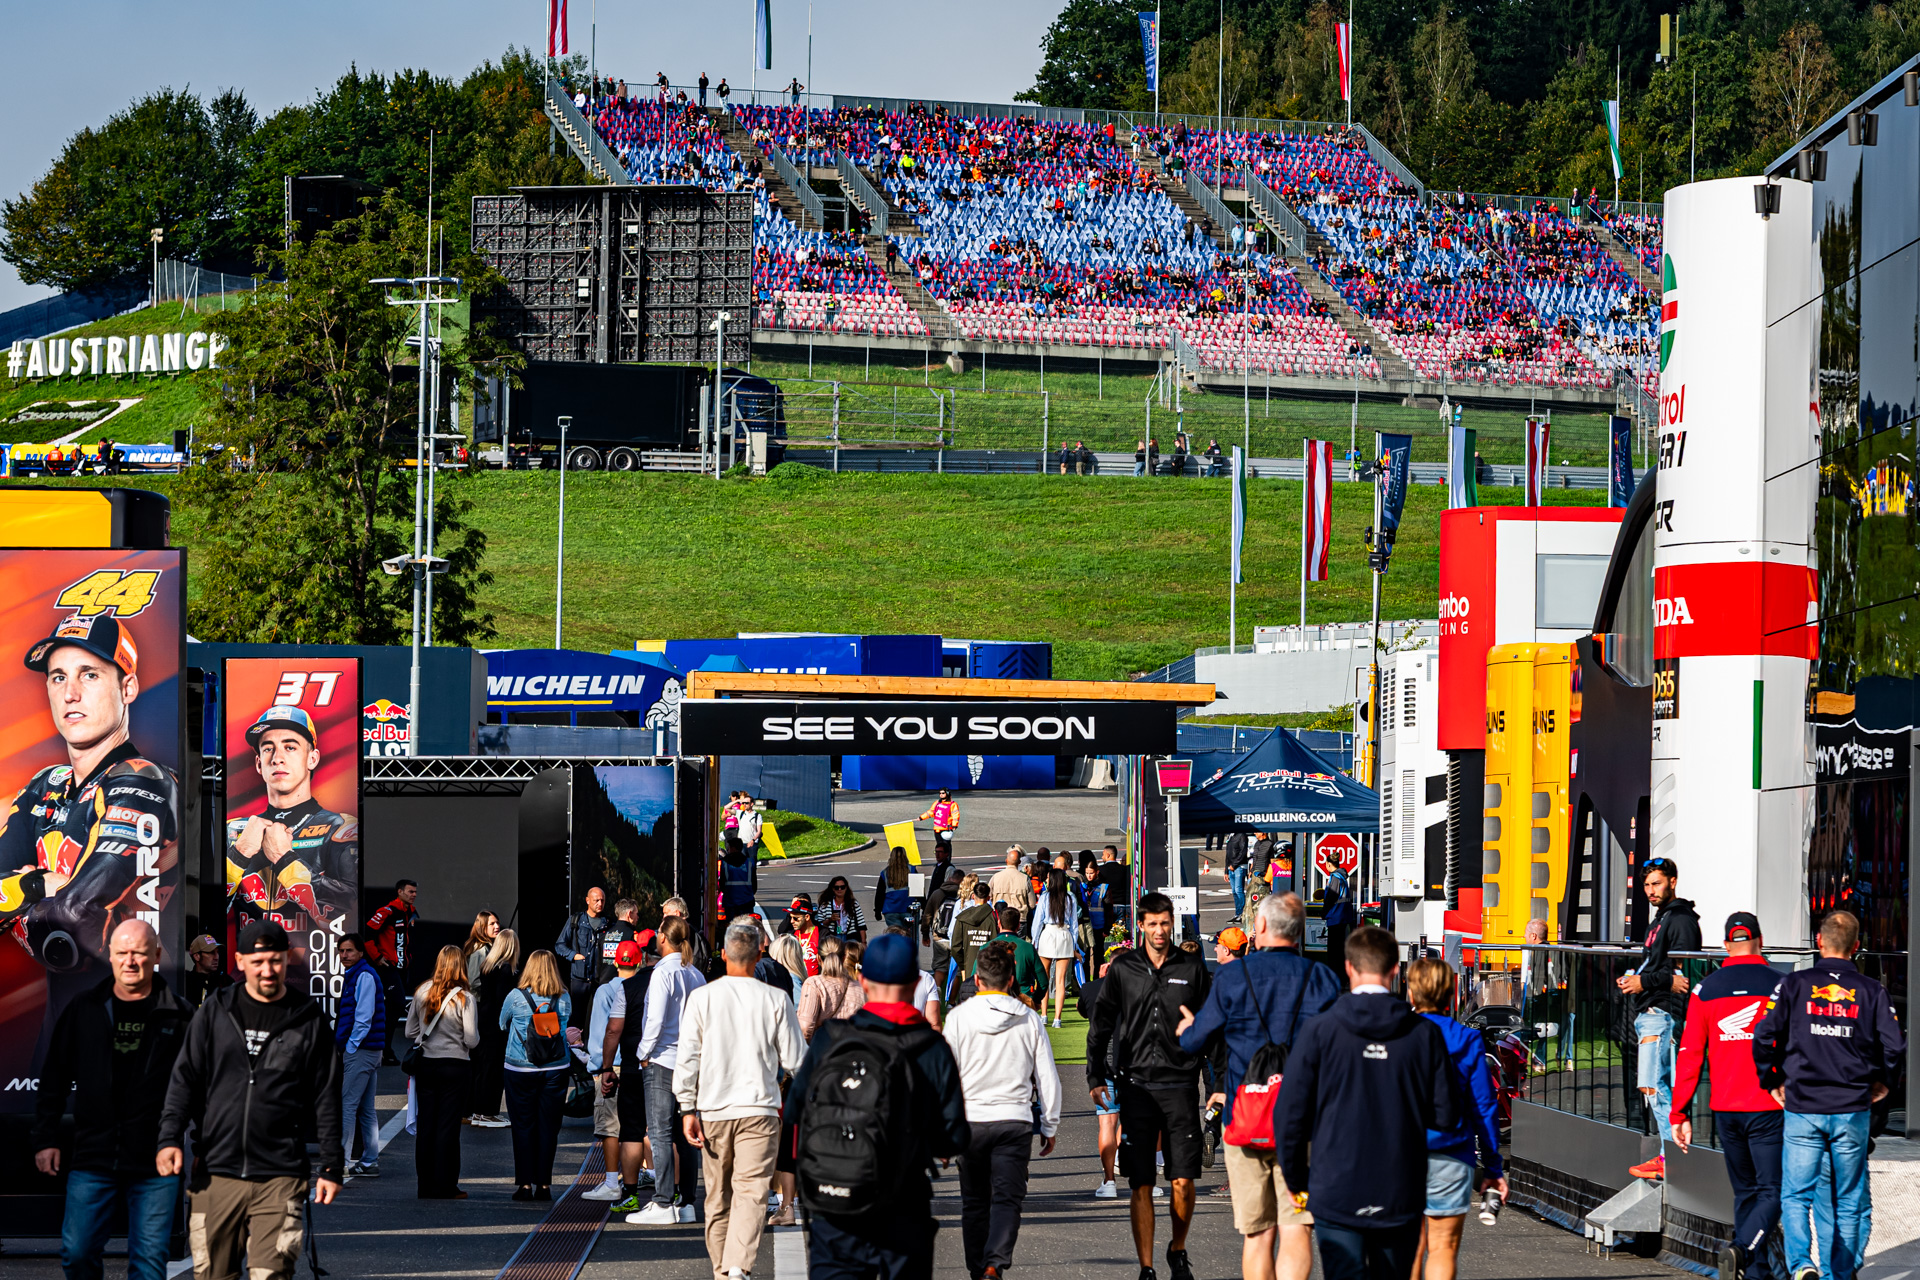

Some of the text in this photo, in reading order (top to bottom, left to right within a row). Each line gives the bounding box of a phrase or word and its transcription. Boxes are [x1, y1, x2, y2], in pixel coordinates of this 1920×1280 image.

[7, 331, 230, 378] #AUSTRIANGP
[1657, 384, 1685, 428] trol
[1658, 431, 1687, 470] ER1
[54, 569, 163, 618] 44
[1439, 592, 1470, 618] embo
[1653, 597, 1694, 627] NDA
[1439, 621, 1469, 636] CING
[272, 671, 343, 706] 37
[486, 675, 645, 696] MICHELIN
[1653, 699, 1674, 716] PORTS
[363, 723, 383, 741] ed
[763, 716, 1095, 740] SEE YOU SOON
[369, 742, 410, 757] AST
[1259, 769, 1302, 779] Red Bull
[108, 786, 165, 803] DAINESE
[1255, 783, 1315, 791] SPIELBERG
[1234, 813, 1337, 823] REDBULLRING.COM
[298, 824, 331, 838] KTM
[1317, 846, 1356, 866] STOP
[270, 913, 308, 932] Bull
[1806, 1001, 1860, 1019] Red Bull
[1811, 1023, 1841, 1037] Mobil
